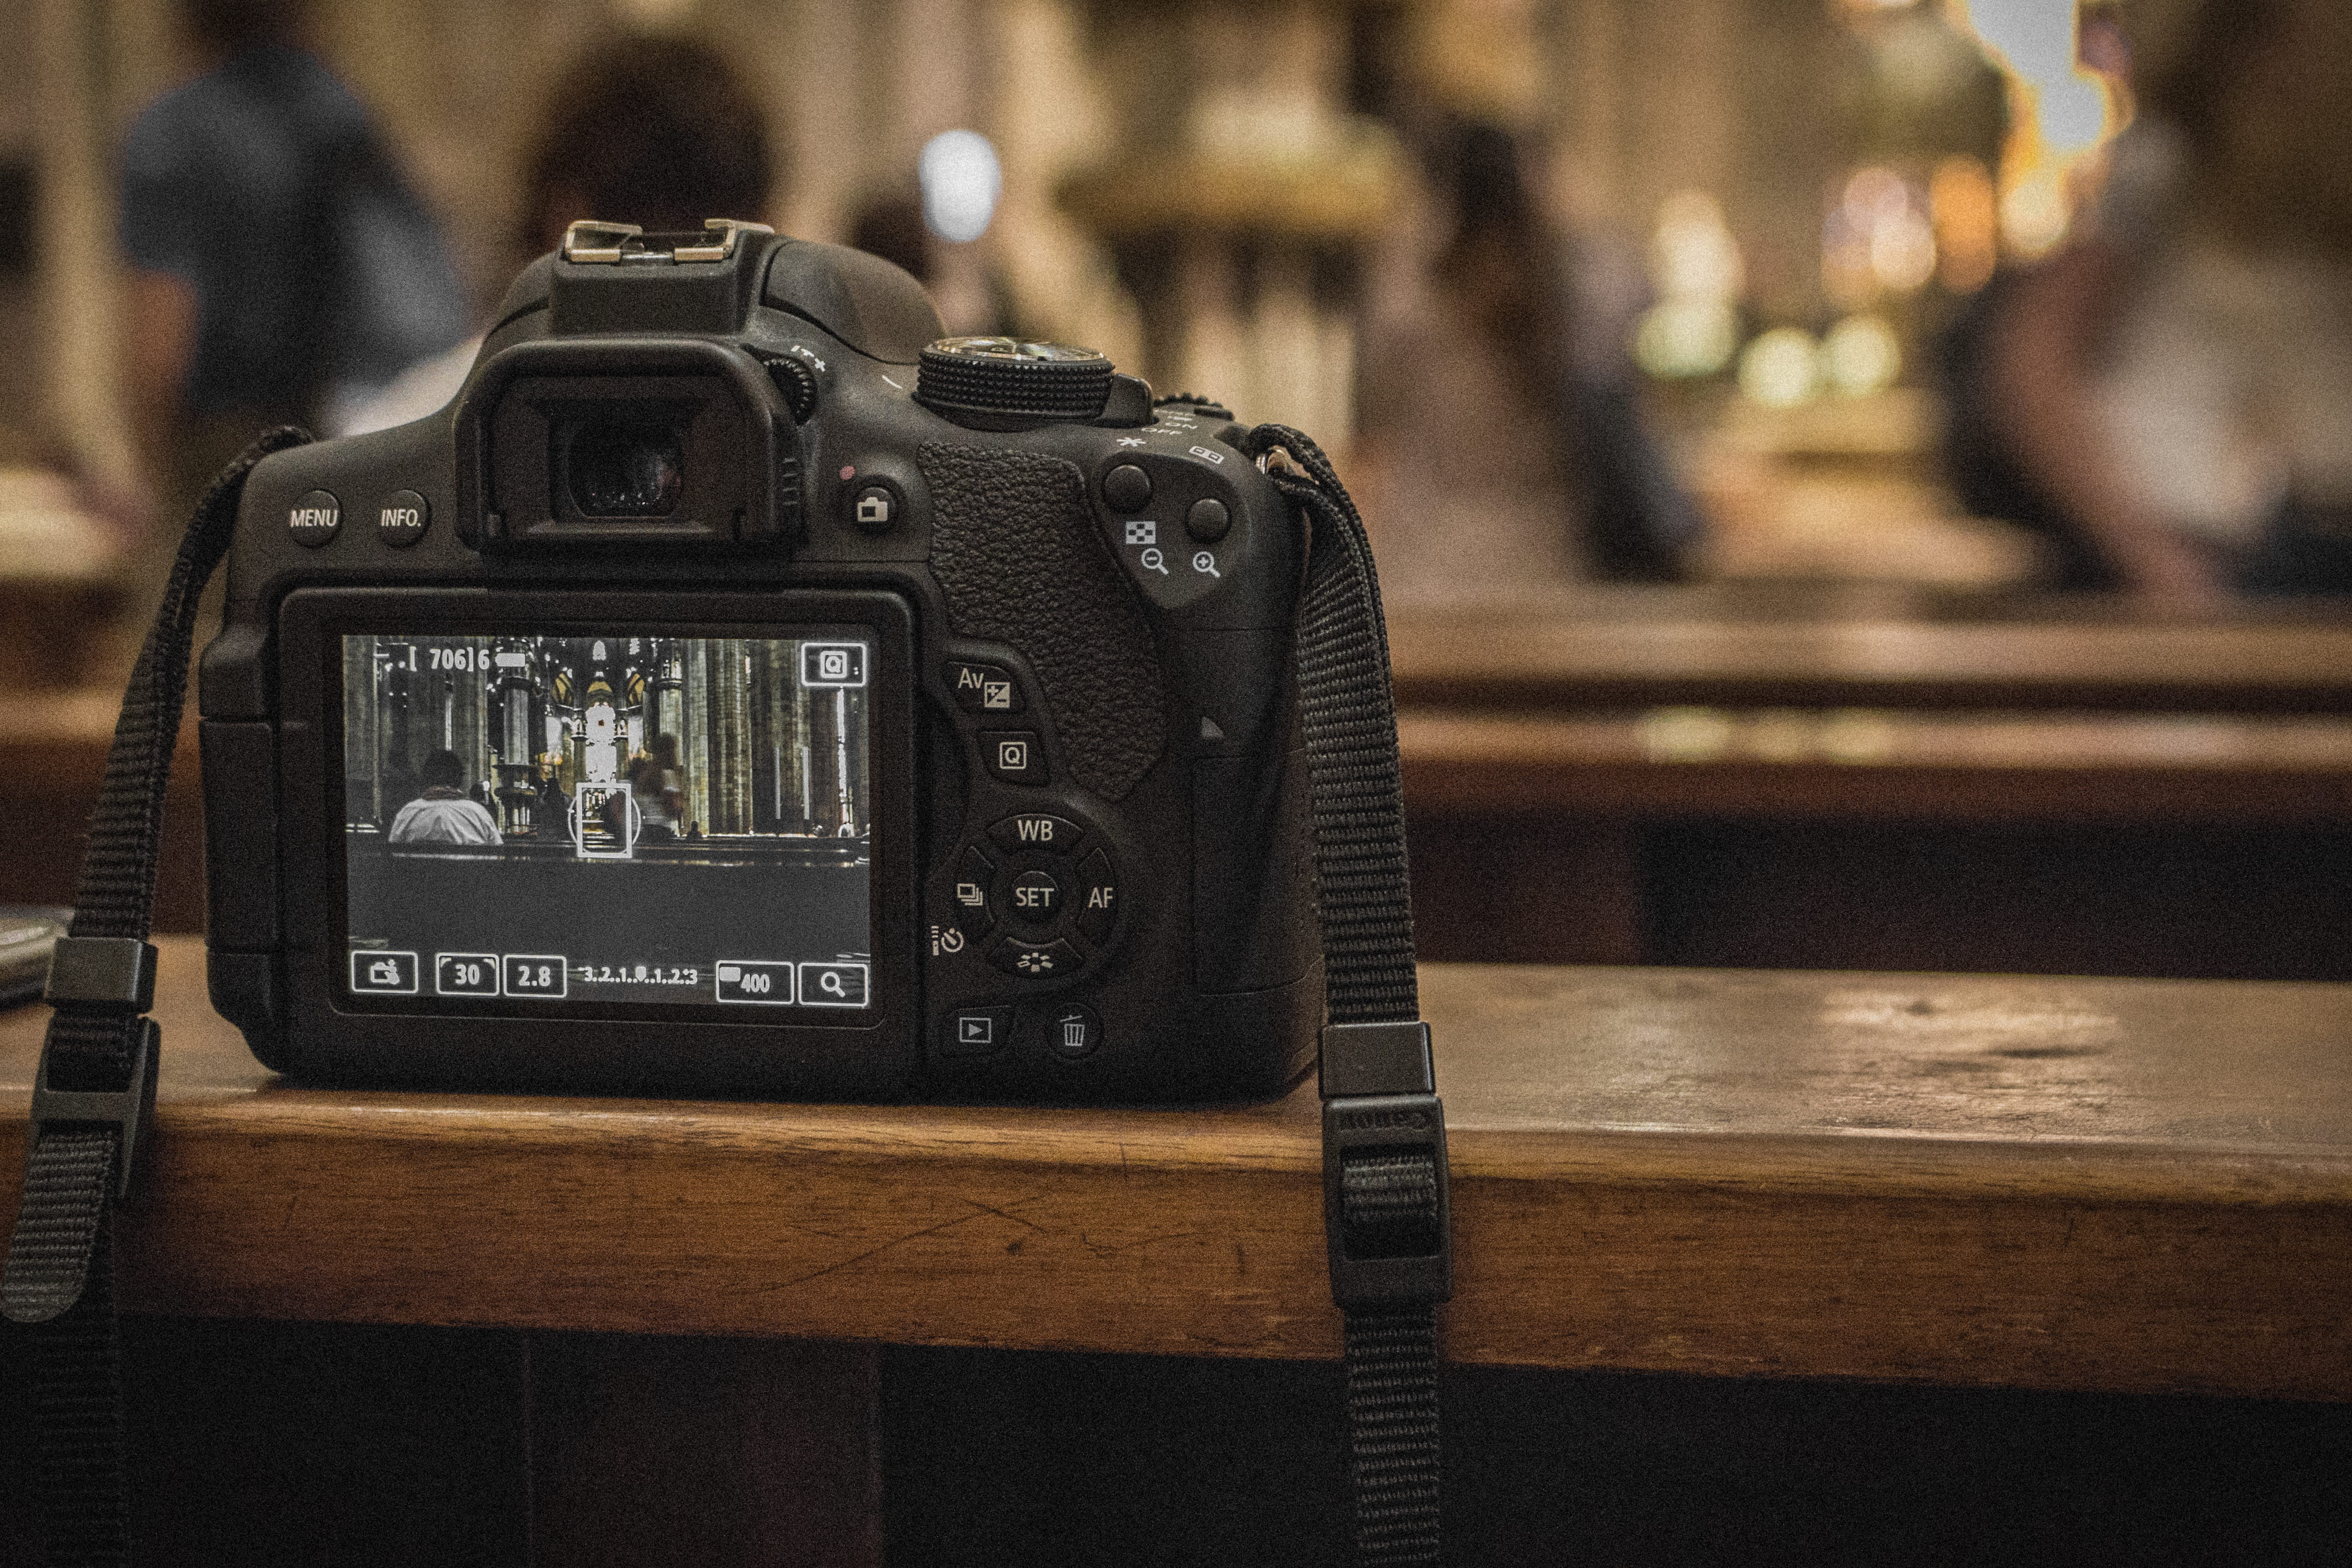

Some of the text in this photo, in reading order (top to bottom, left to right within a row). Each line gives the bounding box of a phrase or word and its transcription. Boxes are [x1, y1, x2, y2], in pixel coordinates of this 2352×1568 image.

[291, 509, 338, 527] MENU
[381, 509, 421, 527] INFO.
[958, 668, 984, 689] Av
[1005, 747, 1020, 764] Q
[1018, 820, 1053, 841] WB
[1016, 887, 1054, 907] SET
[1088, 887, 1113, 908] AF
[455, 964, 480, 985] 30
[518, 965, 551, 987] 2.8
[741, 974, 770, 993] 400
